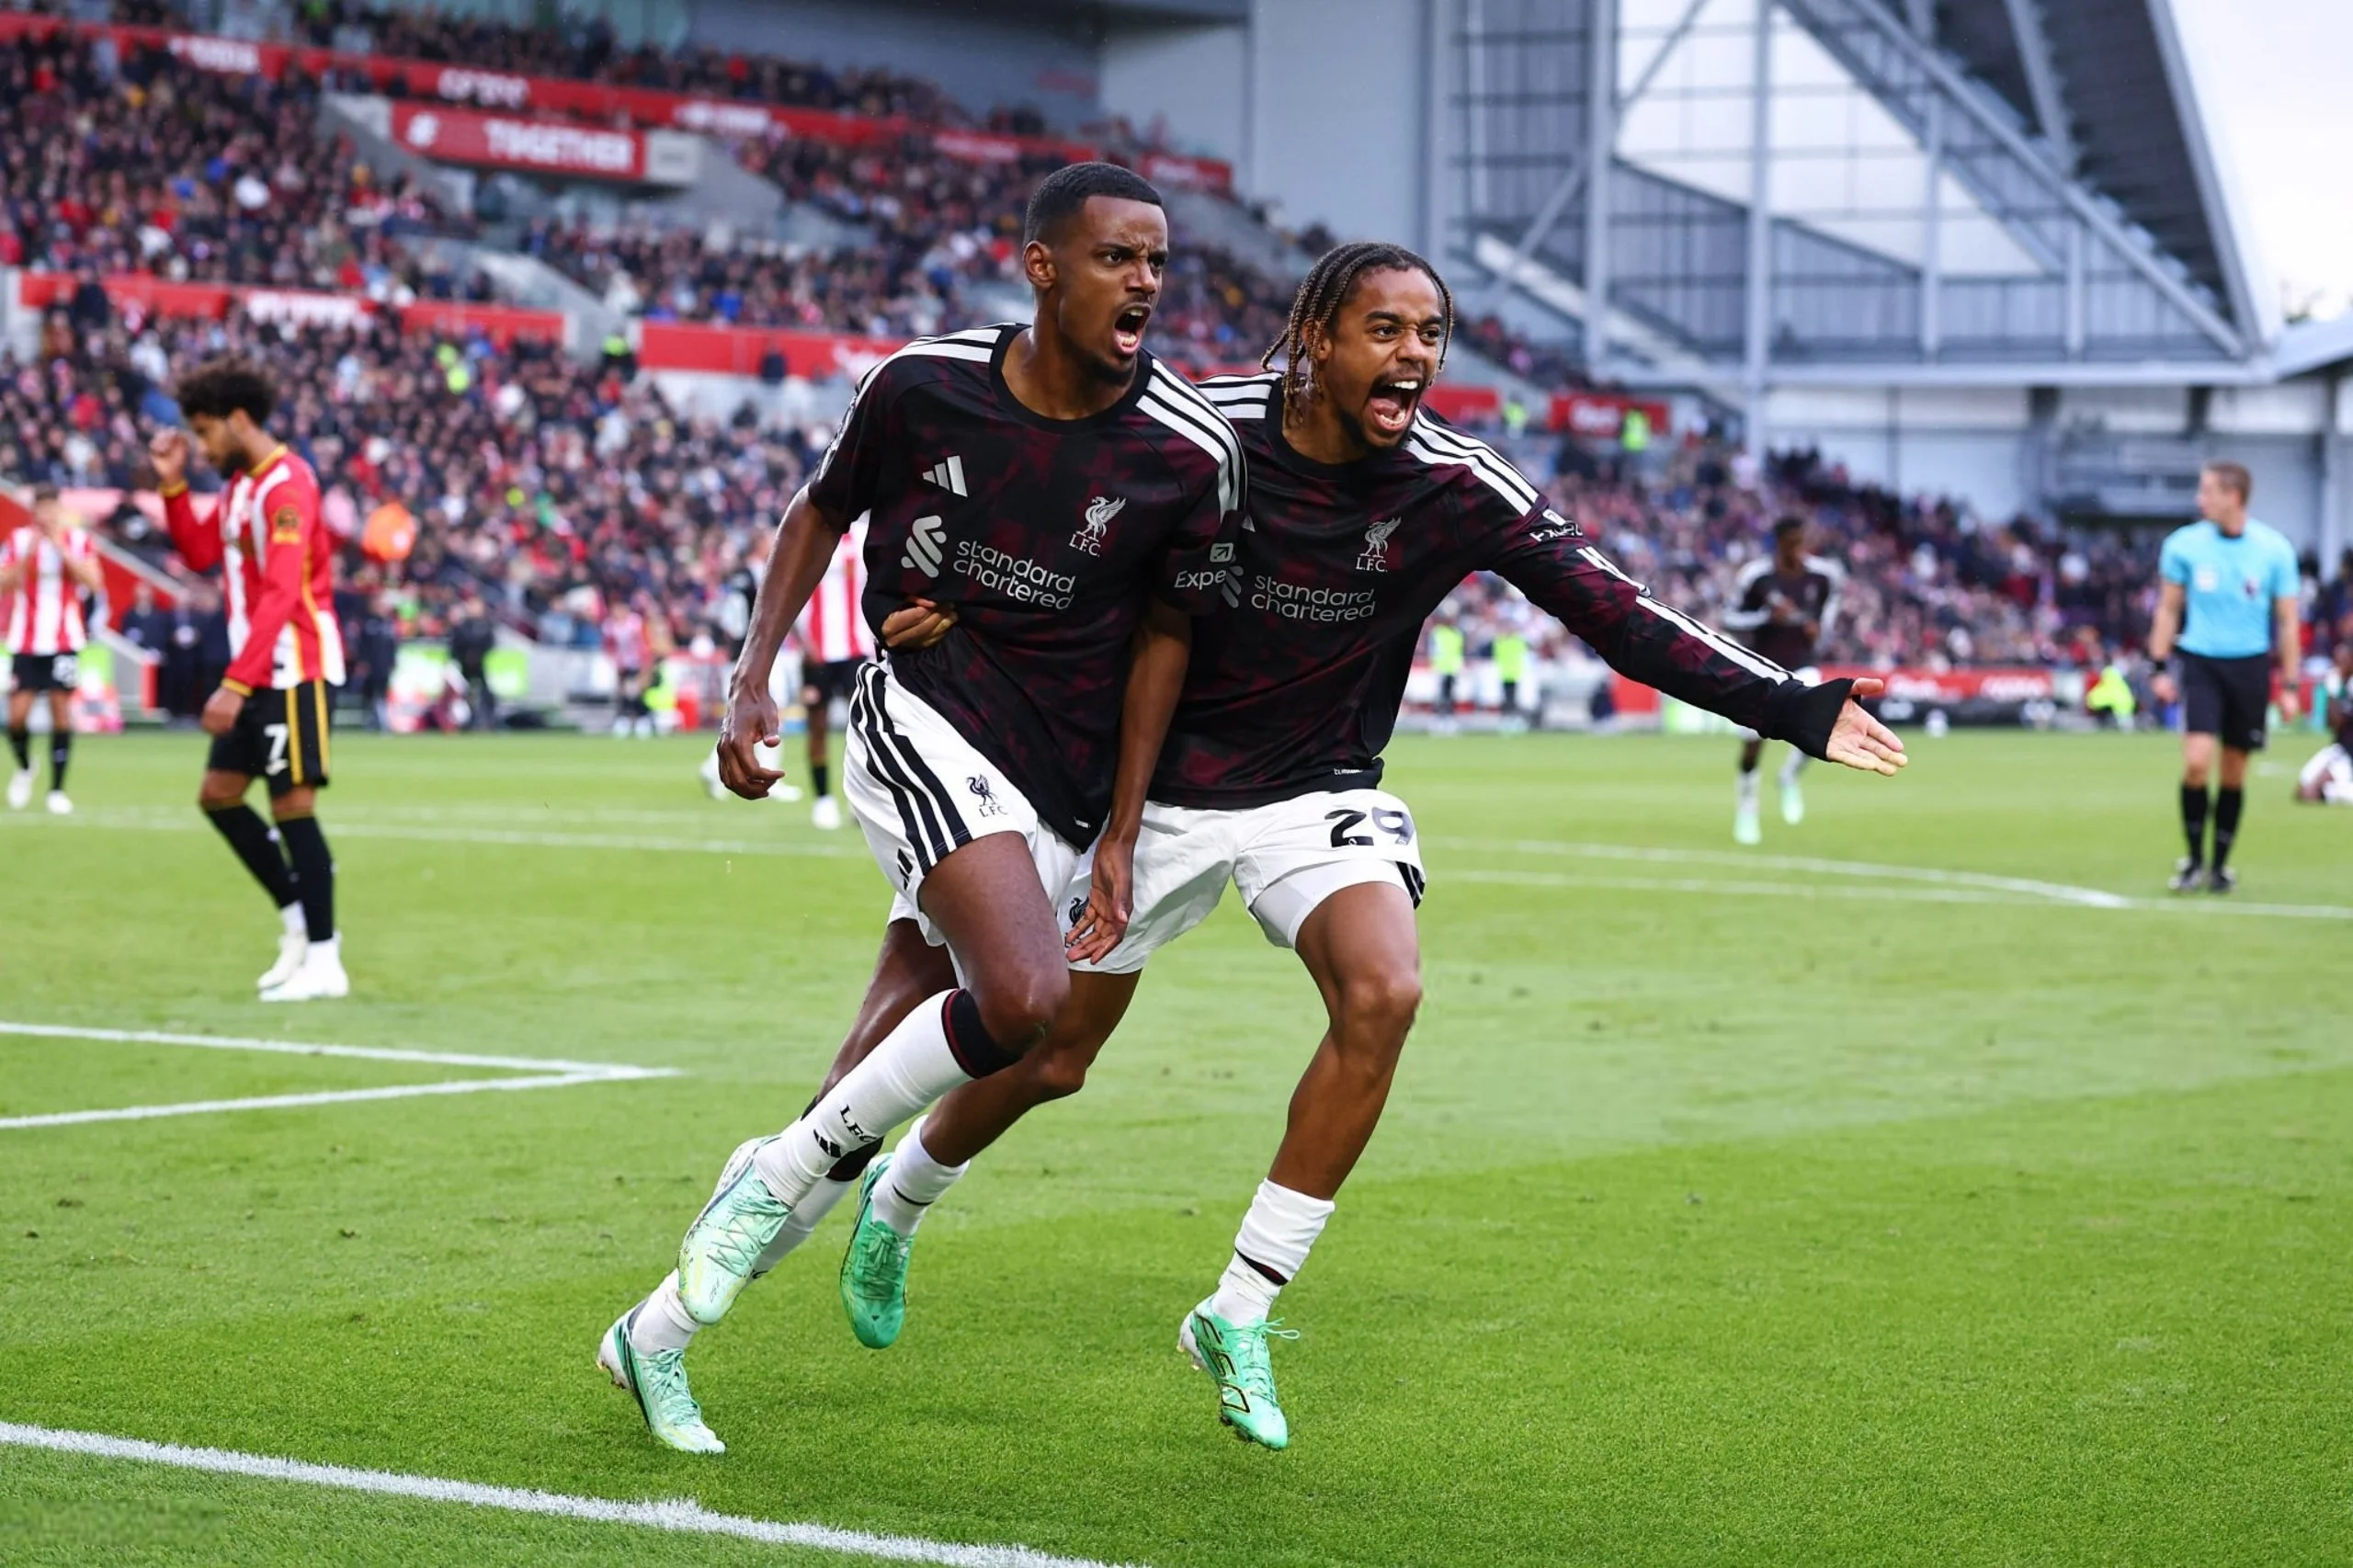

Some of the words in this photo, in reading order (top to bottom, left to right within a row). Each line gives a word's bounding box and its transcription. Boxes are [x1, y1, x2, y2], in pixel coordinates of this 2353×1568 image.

[953, 559, 1074, 610] chartered
[957, 540, 1075, 593] standard
[1251, 594, 1375, 622] chartered
[1255, 574, 1374, 606] standard
[1324, 807, 1415, 847] 29
